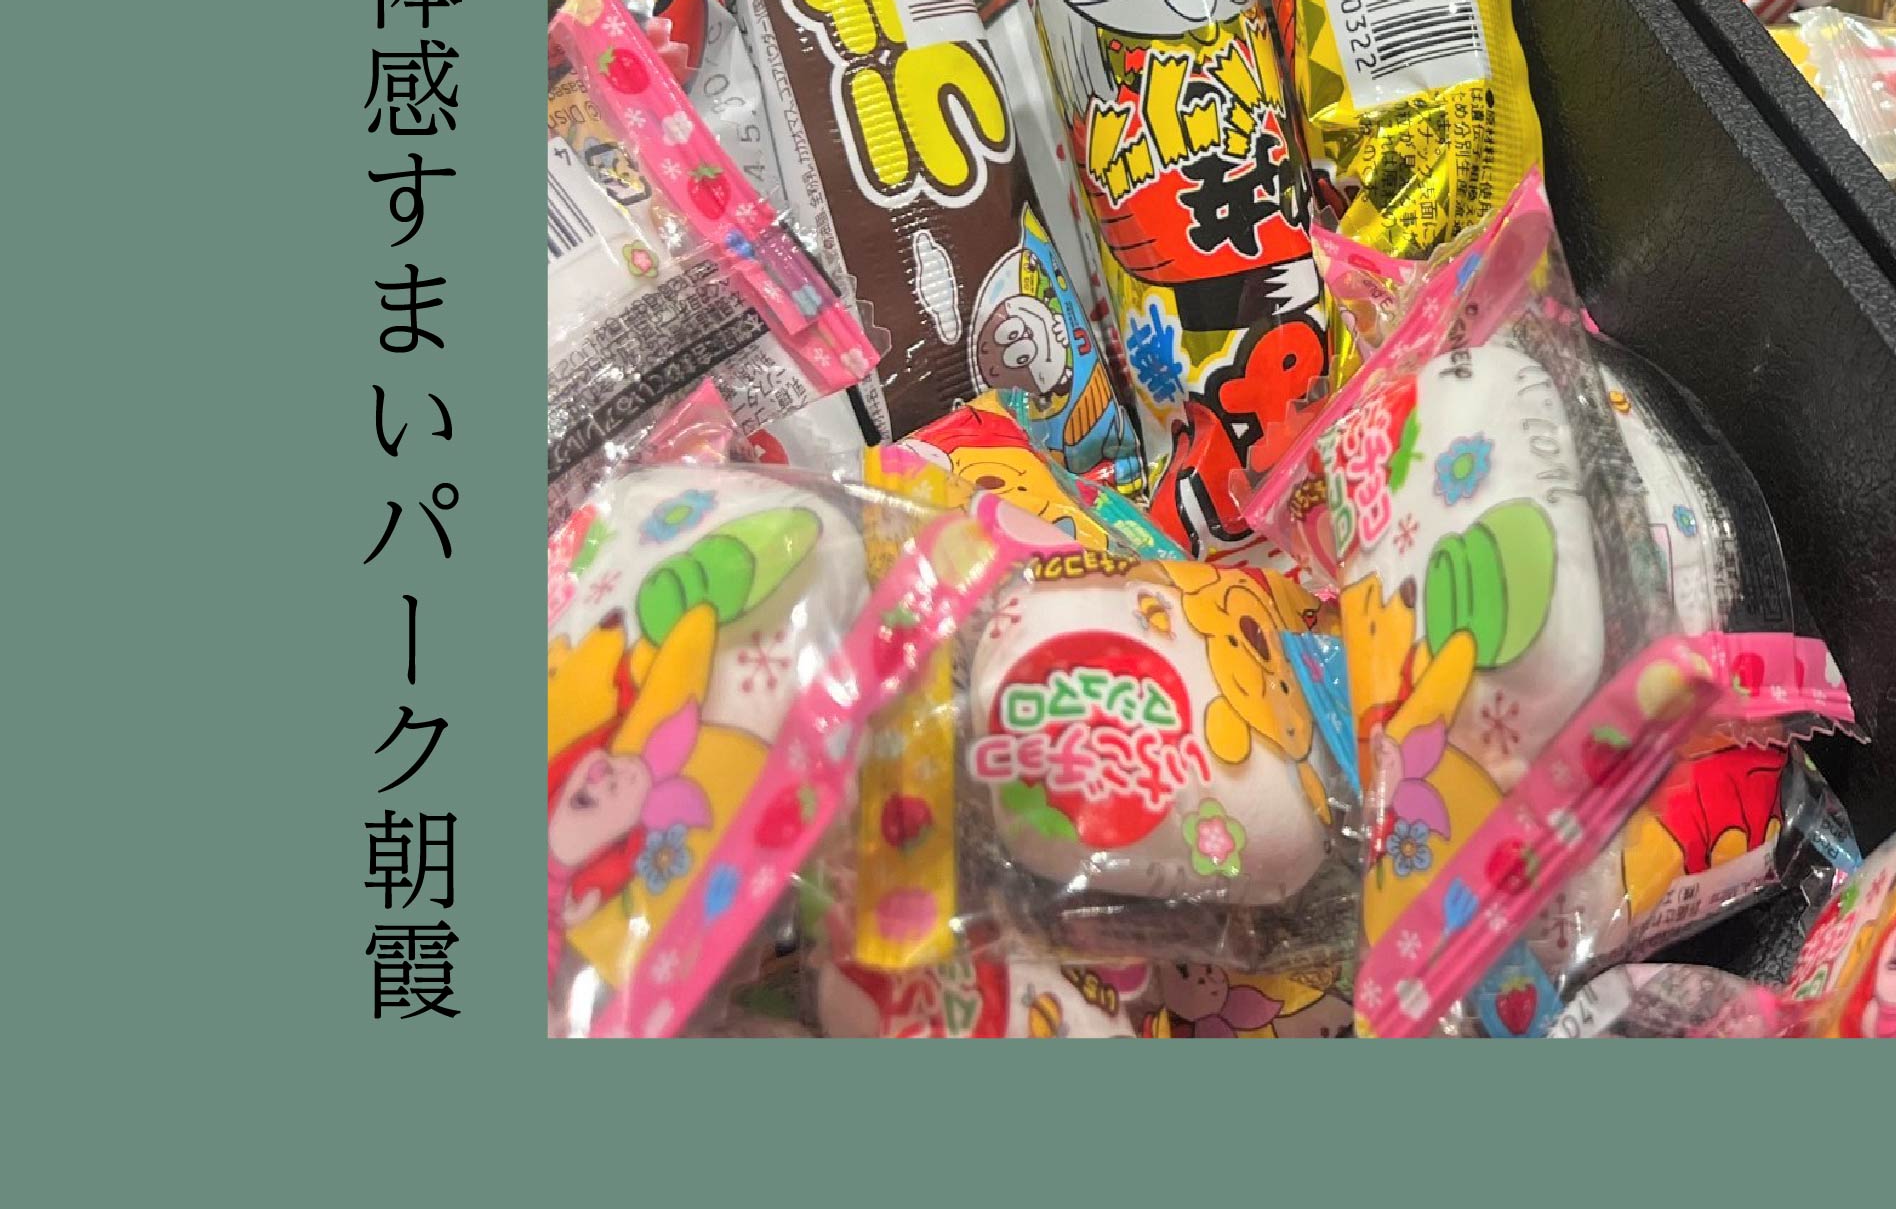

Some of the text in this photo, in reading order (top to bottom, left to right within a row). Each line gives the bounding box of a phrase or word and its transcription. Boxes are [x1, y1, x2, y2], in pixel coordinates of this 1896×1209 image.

[999, 668, 1179, 730] マシュマロ
[968, 725, 1211, 812] いちごチョコ
